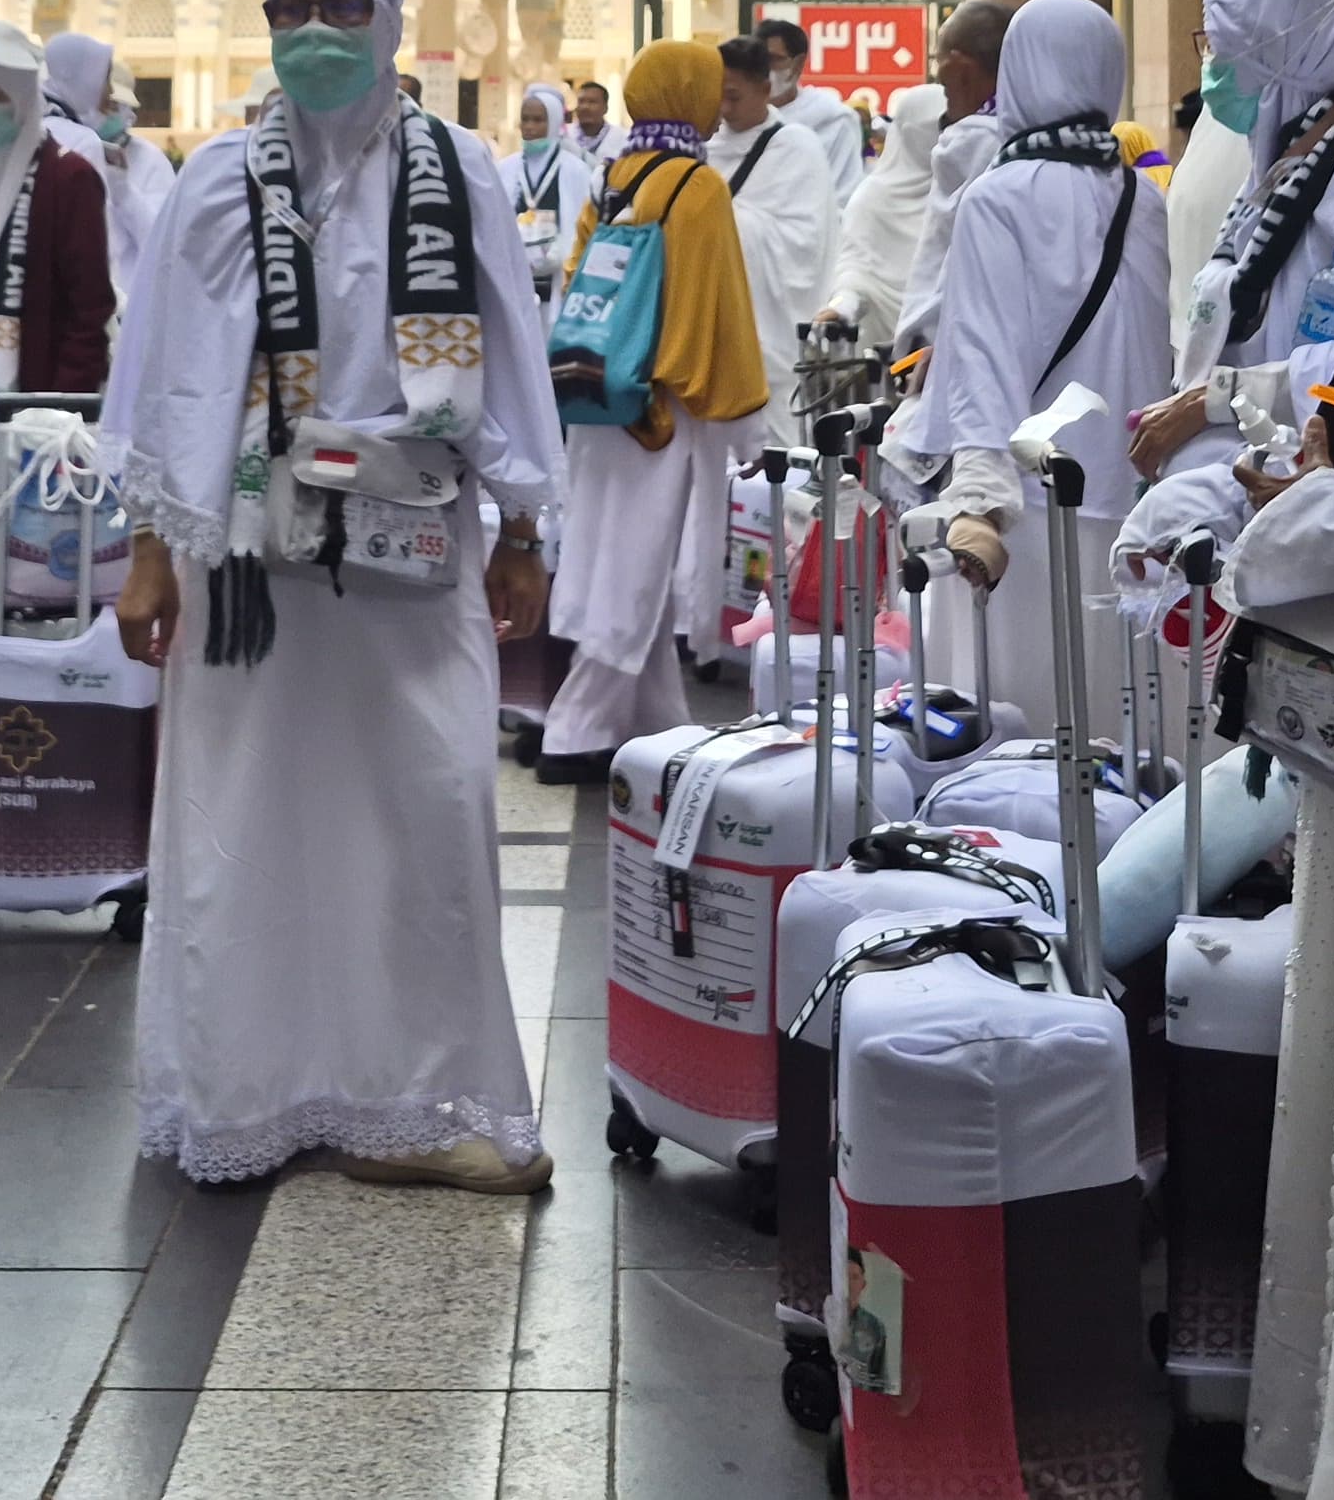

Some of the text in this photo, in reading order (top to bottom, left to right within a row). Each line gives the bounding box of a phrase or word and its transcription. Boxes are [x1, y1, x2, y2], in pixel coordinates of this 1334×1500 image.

[809, 19, 914, 74] ٣٣٠
[563, 290, 616, 323] BSI
[24, 776, 96, 793] Surabaya
[672, 777, 710, 857] KARSAN
